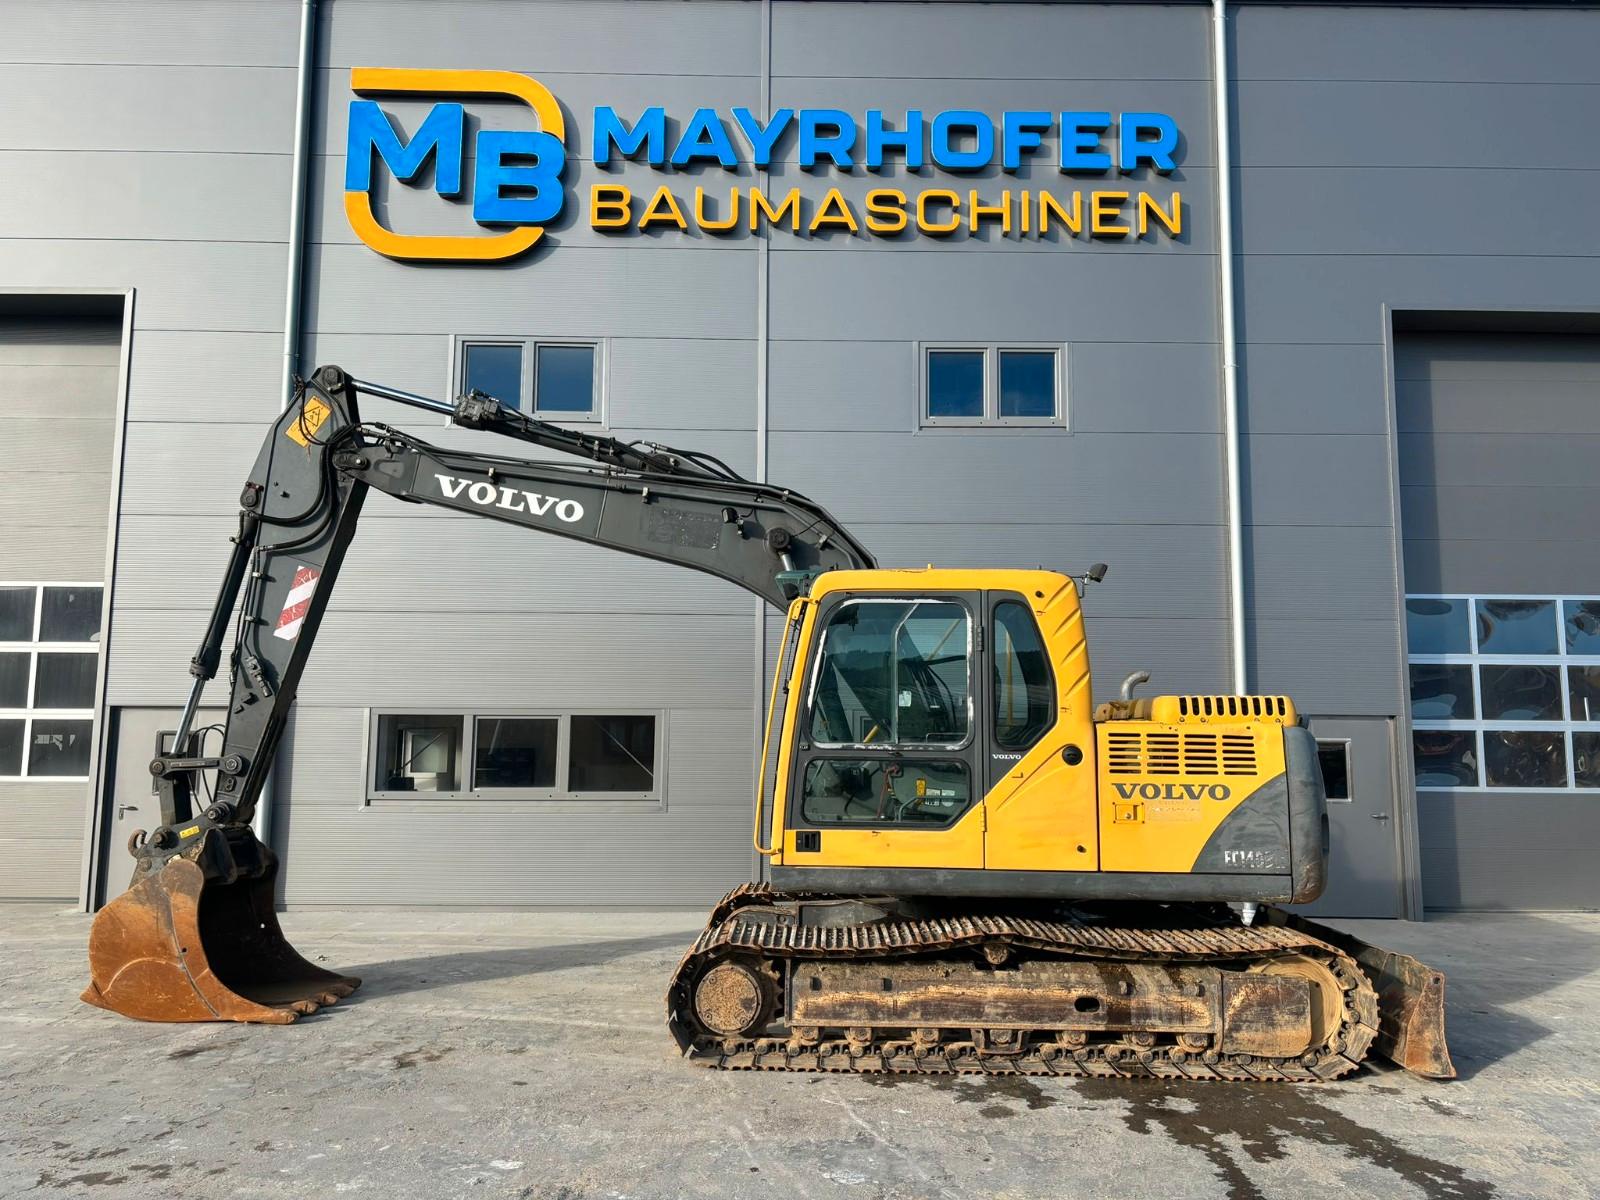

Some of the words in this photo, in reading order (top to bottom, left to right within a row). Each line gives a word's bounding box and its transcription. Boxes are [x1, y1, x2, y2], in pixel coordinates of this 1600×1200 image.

[344, 100, 566, 224] MB
[593, 106, 1179, 171] MAYRHOFER
[590, 184, 1182, 236] BAUMASCHINEN
[434, 474, 584, 522] VOLVO
[1112, 783, 1231, 801] VOLVO
